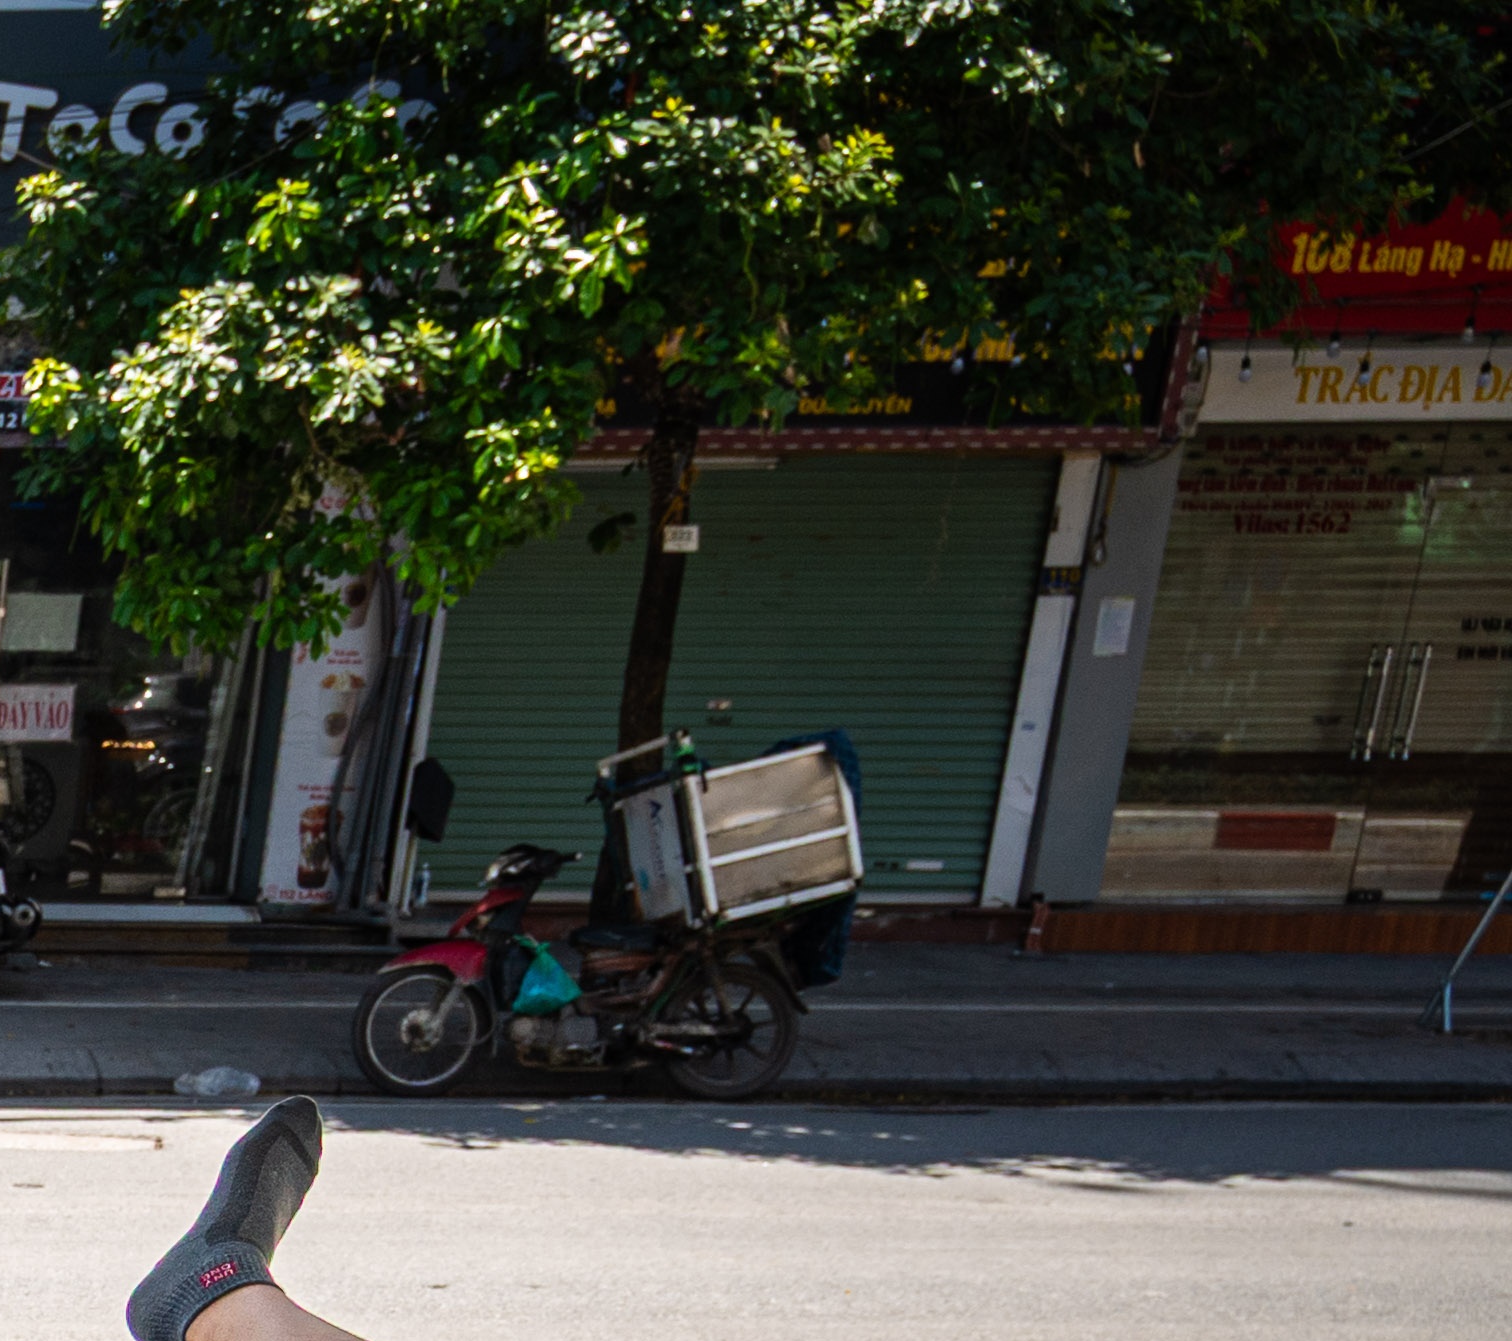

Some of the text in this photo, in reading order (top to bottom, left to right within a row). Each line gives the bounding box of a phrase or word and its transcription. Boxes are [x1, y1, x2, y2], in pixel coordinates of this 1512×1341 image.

[1359, 241, 1424, 277] Láng
[1430, 240, 1466, 278] Hạ
[1398, 364, 1463, 412] ĐỊA
